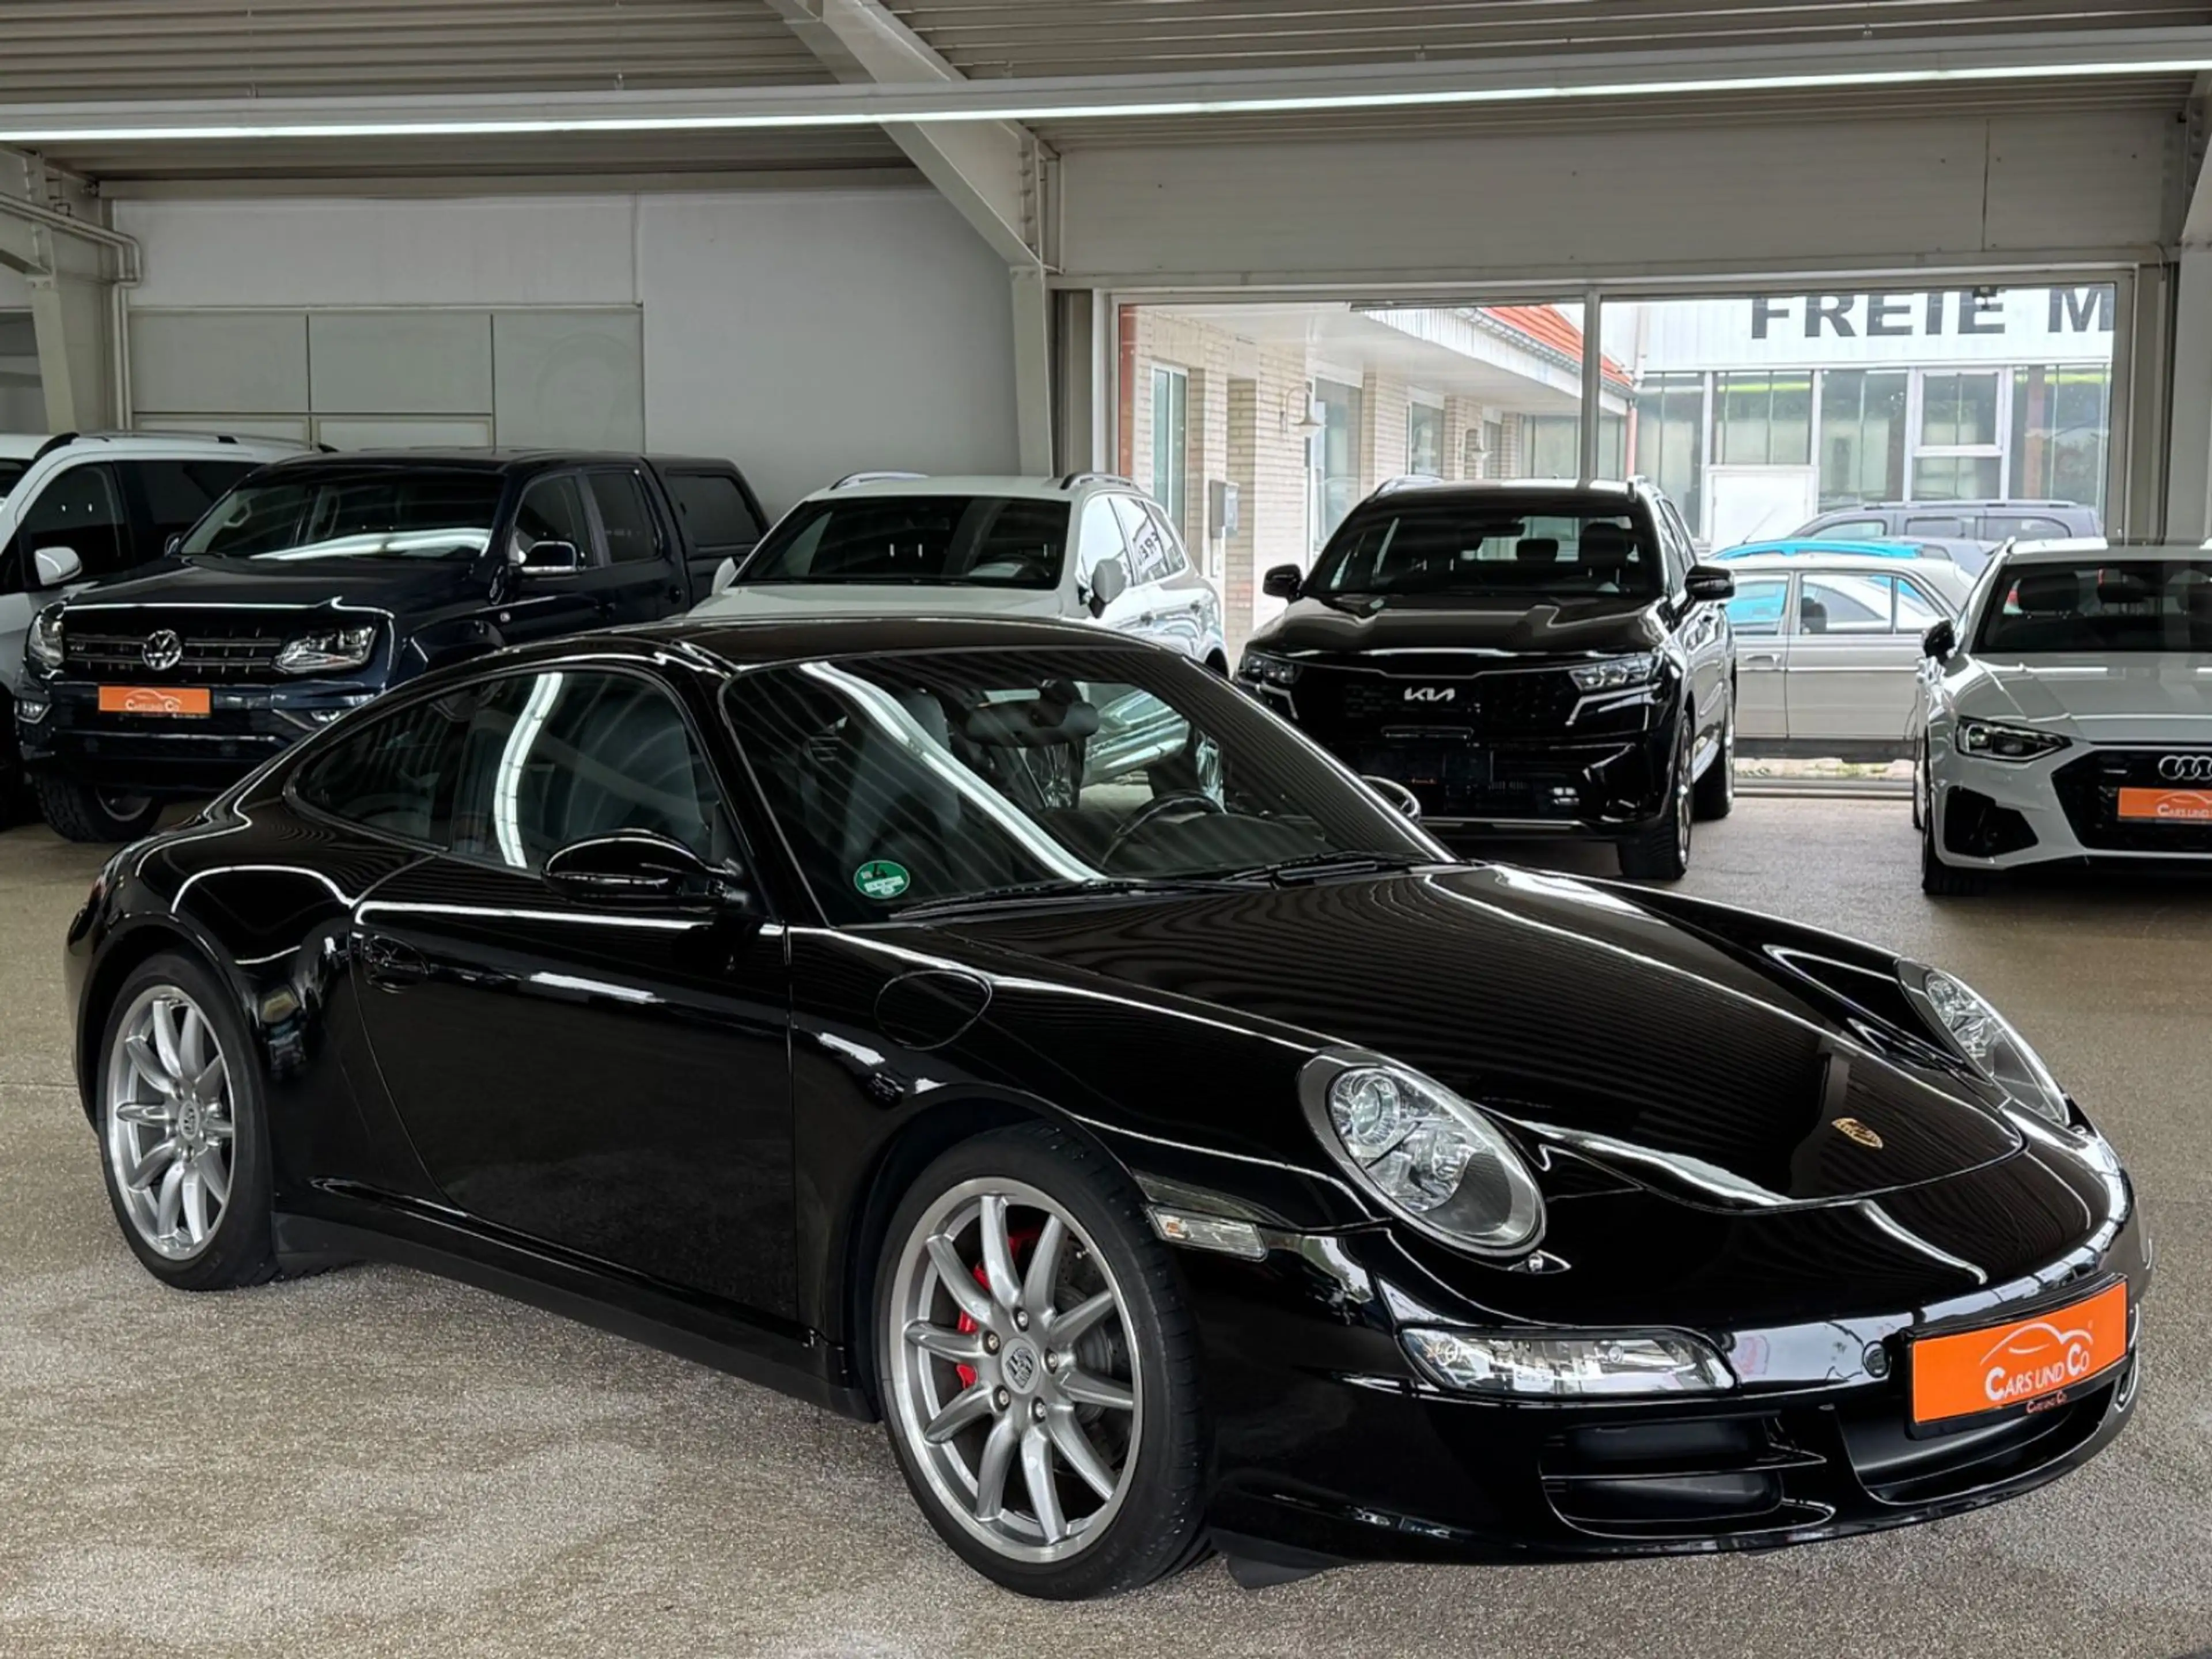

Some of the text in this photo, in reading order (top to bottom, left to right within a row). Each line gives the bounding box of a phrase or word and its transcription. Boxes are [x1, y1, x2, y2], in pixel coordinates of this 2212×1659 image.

[1752, 290, 2005, 339] FREIE
[1985, 1366, 2033, 1400] CARS
[2035, 1361, 2065, 1389] UND
